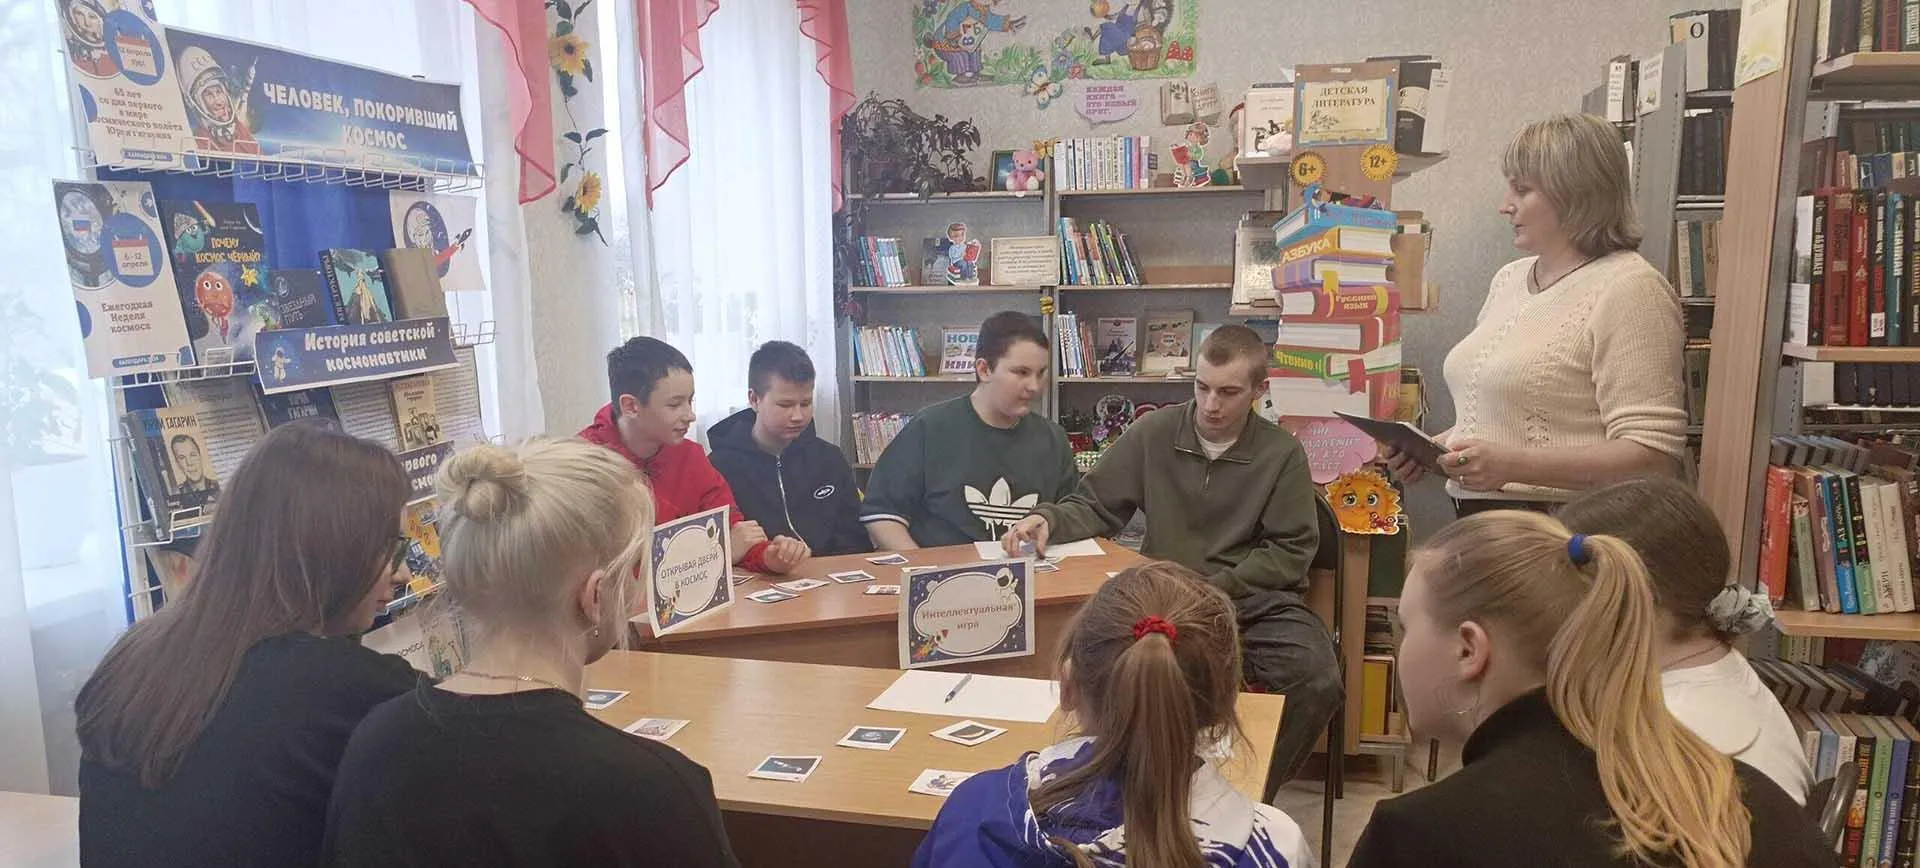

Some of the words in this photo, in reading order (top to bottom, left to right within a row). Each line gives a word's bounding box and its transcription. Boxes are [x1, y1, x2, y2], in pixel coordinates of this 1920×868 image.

[1319, 85, 1369, 97] ДЕТСКАЯ
[98, 97, 111, 105] со
[111, 99, 127, 107] дня
[127, 101, 163, 111] первого
[263, 82, 350, 118] ЧЕЛОВЕК,
[353, 96, 458, 131] ПОКОРИВШИЙ
[1311, 97, 1377, 109] ЛИТЕРАТУРА
[96, 116, 151, 129] осмического
[342, 124, 408, 150] КОСМОС
[1369, 155, 1387, 169] 12+
[1299, 162, 1317, 176] 6+
[211, 236, 240, 249] ПОЧЕМУ
[1281, 237, 1331, 264] АЗБУКА
[195, 251, 227, 264] КОСМОС
[121, 260, 149, 270] апреля
[101, 301, 153, 313] Ежегодная
[110, 312, 146, 324] Неделя
[110, 322, 152, 334] космоса
[304, 331, 367, 354] История
[369, 321, 436, 345] советской
[947, 333, 977, 343] НОВ
[325, 346, 427, 372] космонавтики
[944, 360, 976, 369] КНИ
[165, 414, 198, 430] ГАГАРИН
[661, 559, 697, 579] ОТКРЫВАЯ
[697, 551, 719, 568] ДВЕРИ
[680, 570, 708, 588] КОСМОС
[921, 603, 1015, 619] Интеллектуальная
[957, 622, 979, 631] игра
